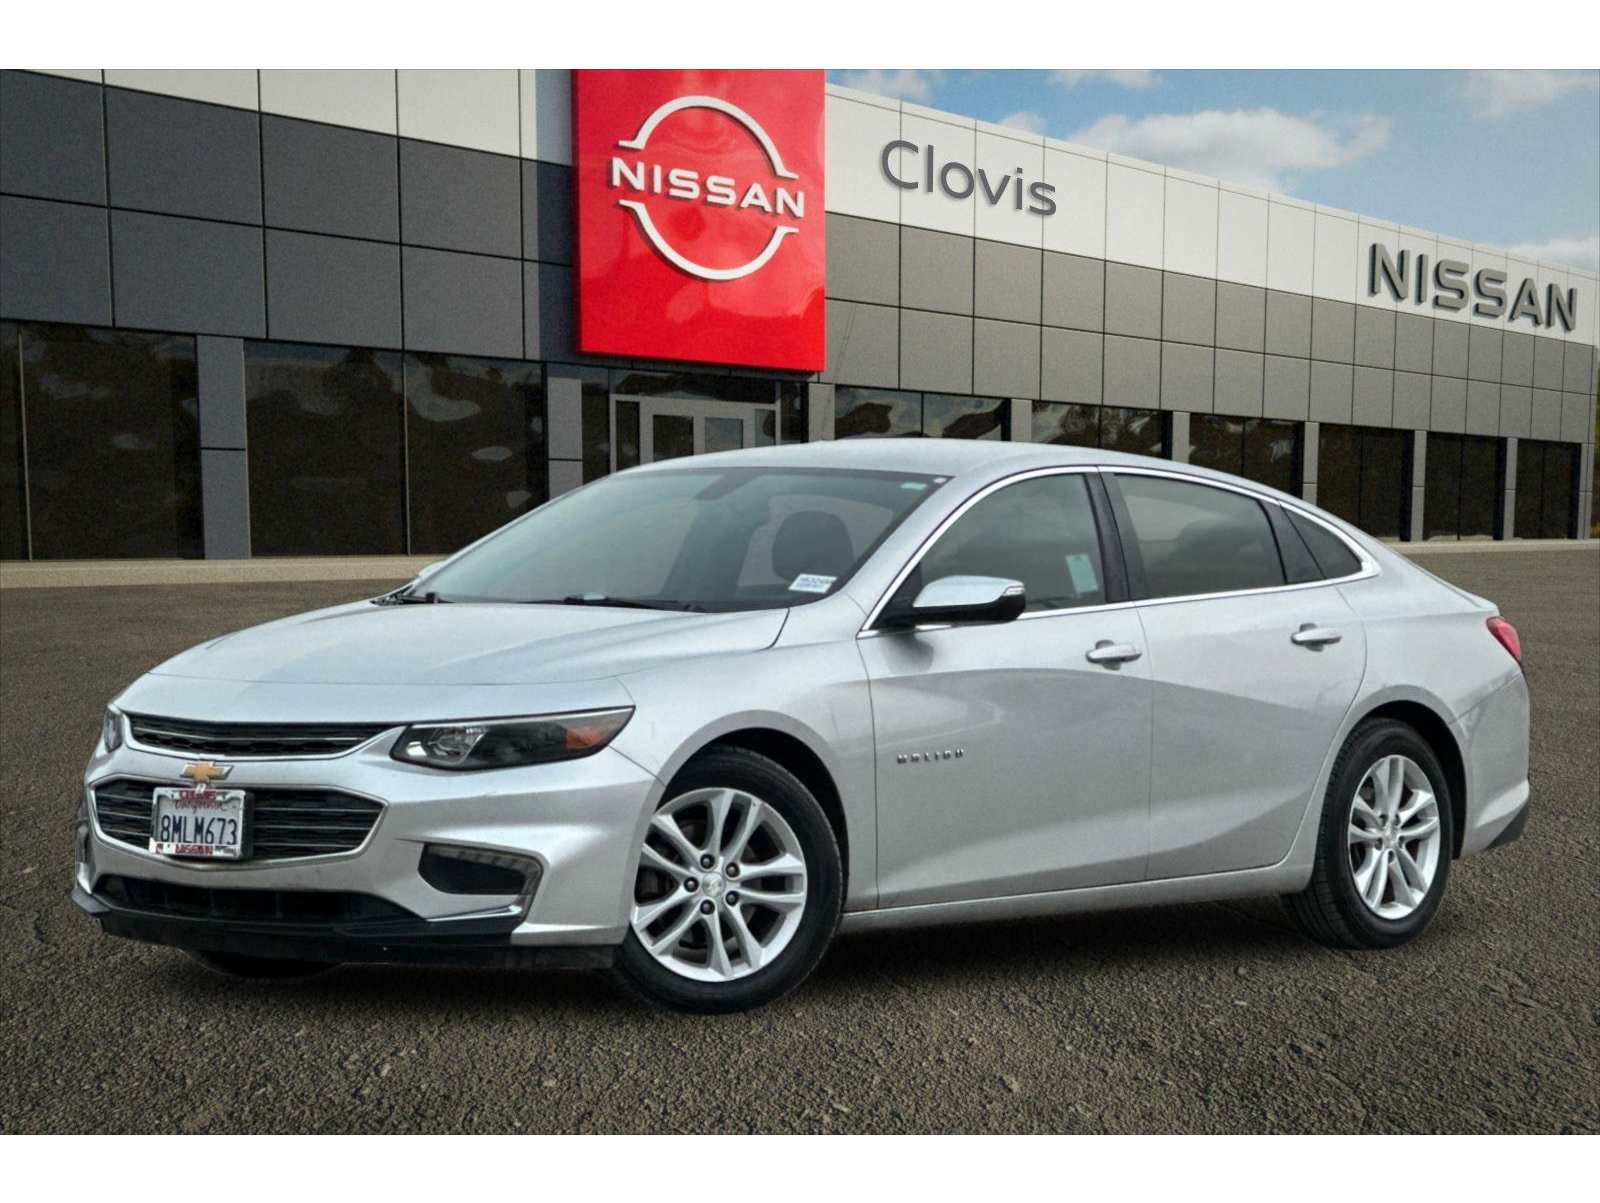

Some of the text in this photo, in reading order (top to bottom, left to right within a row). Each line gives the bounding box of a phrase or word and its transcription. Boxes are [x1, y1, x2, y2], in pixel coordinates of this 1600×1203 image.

[611, 156, 804, 218] NISSAN
[881, 140, 1057, 216] Clovis
[1368, 242, 1578, 332] NISSAN
[160, 814, 238, 846] 8MLM673
